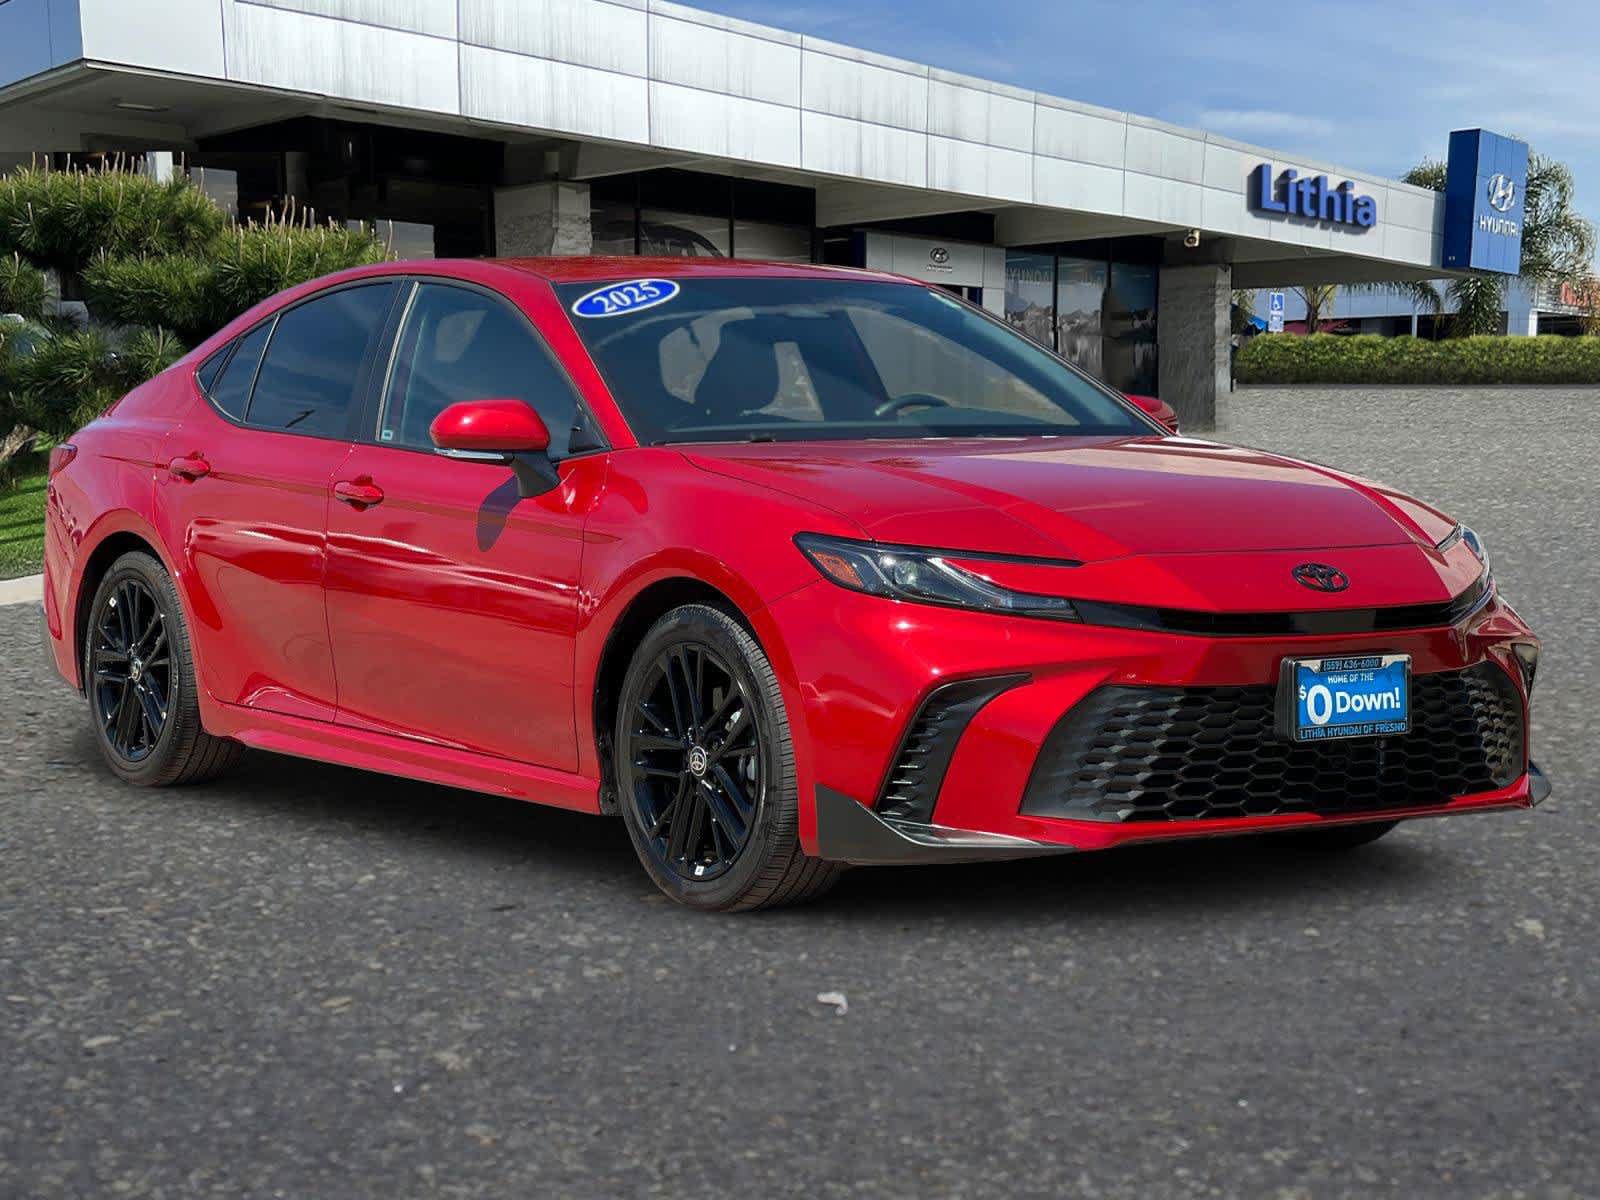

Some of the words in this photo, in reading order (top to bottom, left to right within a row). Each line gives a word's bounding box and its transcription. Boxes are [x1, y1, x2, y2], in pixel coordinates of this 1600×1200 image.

[1259, 163, 1377, 228] Lithia
[592, 281, 660, 312] 2025
[1328, 675, 1348, 684] HOME
[1349, 673, 1360, 682] OF
[1361, 672, 1374, 682] THE
[1335, 686, 1401, 713] Down!
[1300, 728, 1325, 739] LITHIA
[1327, 725, 1361, 737] HYUNDAI
[1363, 723, 1374, 734] OF
[1375, 722, 1405, 733] FRESNO
